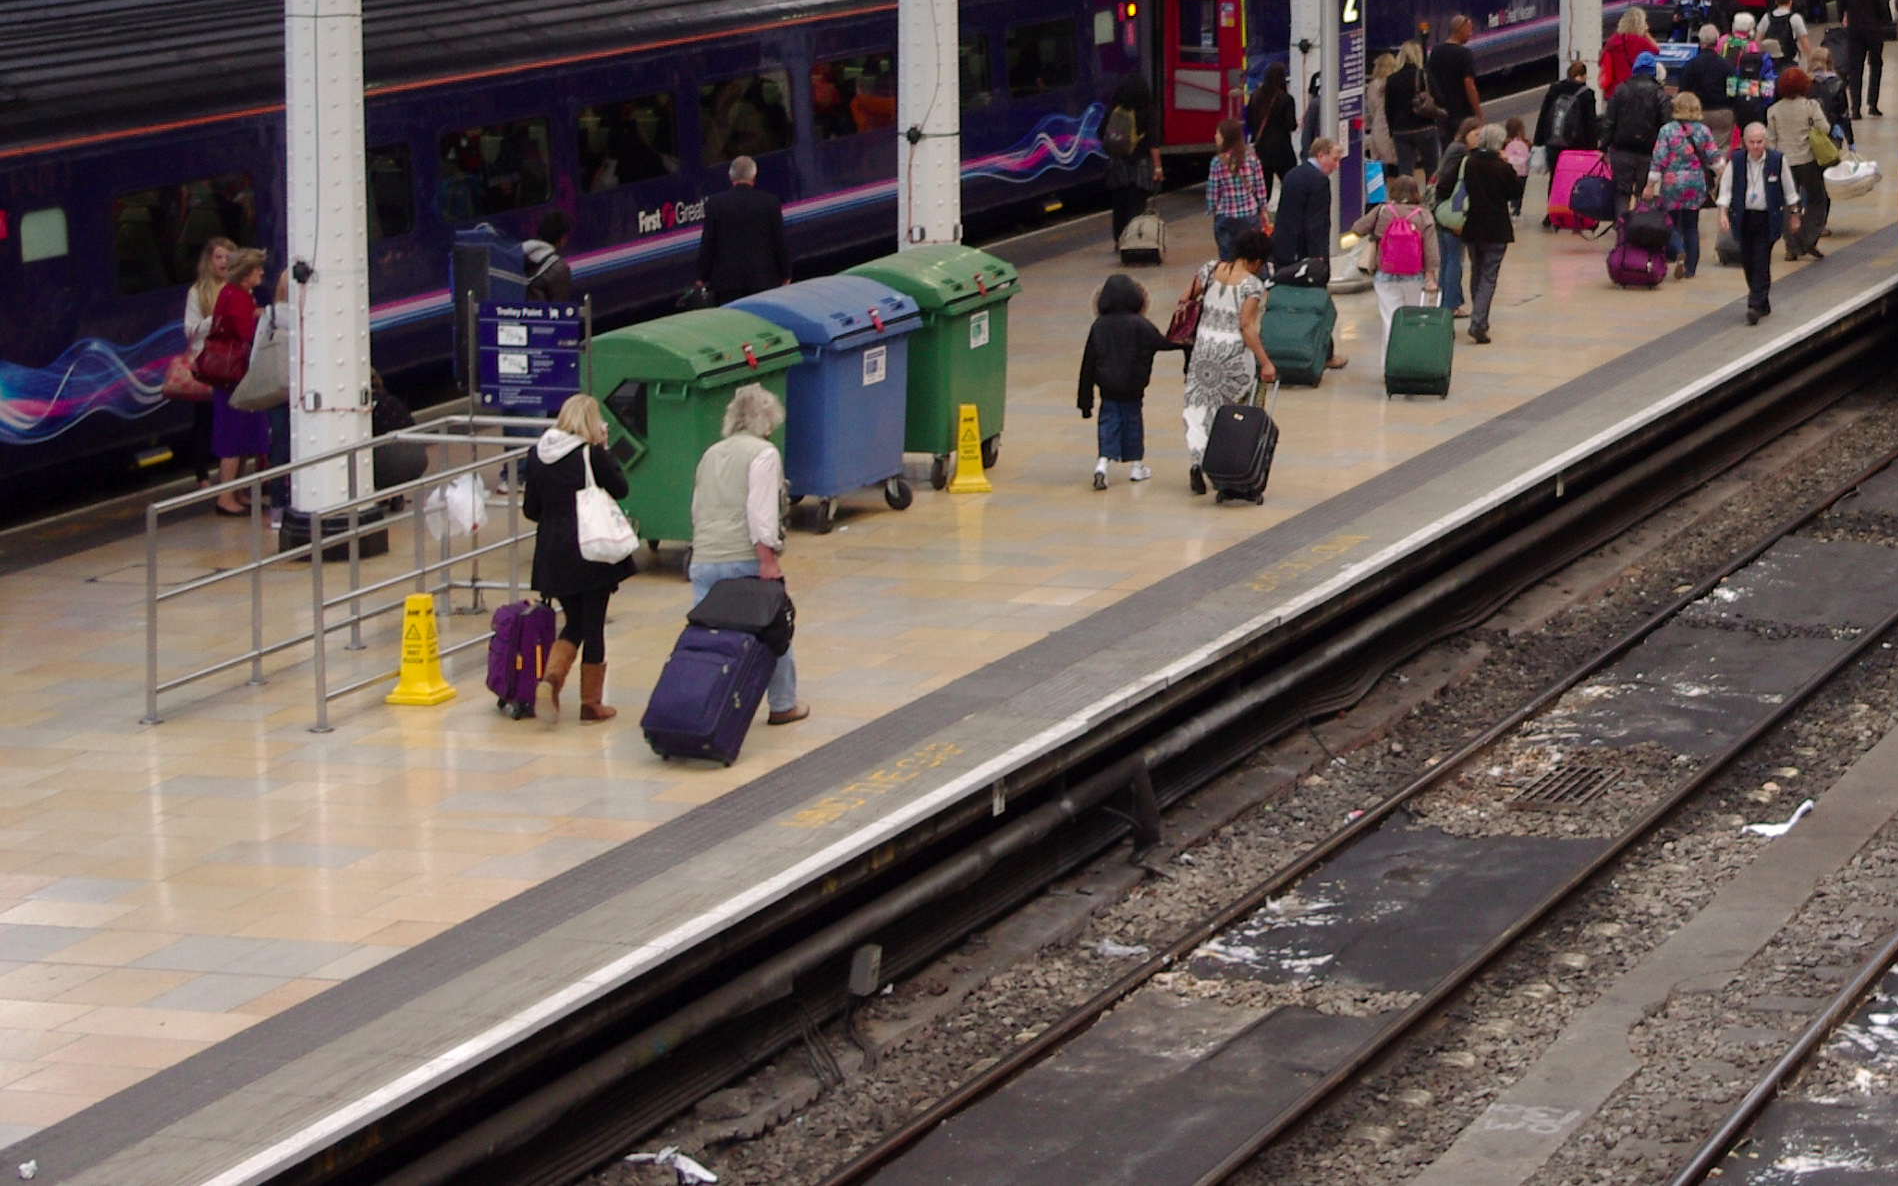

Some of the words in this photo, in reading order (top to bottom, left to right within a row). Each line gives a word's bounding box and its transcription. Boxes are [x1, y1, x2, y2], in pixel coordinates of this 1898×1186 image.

[637, 208, 662, 234] First
[674, 200, 706, 225] Great
[496, 306, 521, 319] Trolley
[522, 307, 544, 317] Point
